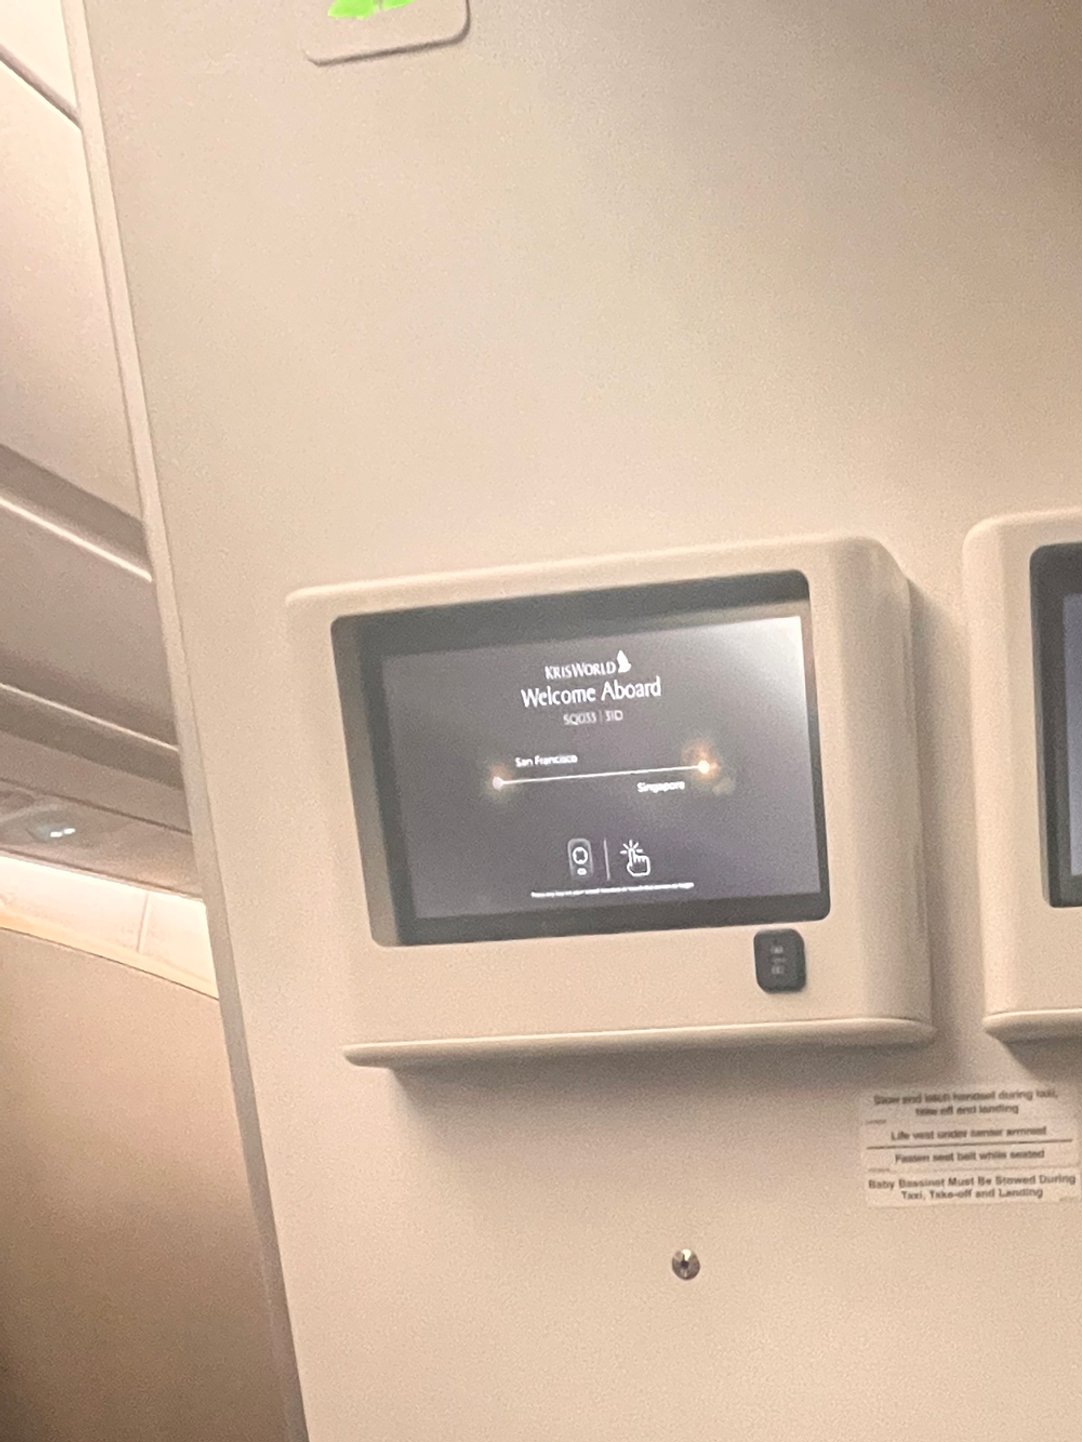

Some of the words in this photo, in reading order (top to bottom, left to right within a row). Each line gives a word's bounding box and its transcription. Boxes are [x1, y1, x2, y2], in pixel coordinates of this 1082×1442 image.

[544, 661, 617, 680] KRISWORLD
[520, 685, 596, 708] Welcome
[601, 675, 662, 701] Aboard
[605, 710, 624, 722] 31D
[515, 756, 533, 767] San
[534, 754, 578, 766] Francisco
[637, 781, 685, 793] Singapore
[998, 1089, 1033, 1101] during
[956, 1106, 977, 1115] and
[978, 1104, 1019, 1114] landing
[890, 1130, 910, 1141] Life
[911, 1129, 934, 1139] vest
[936, 1128, 968, 1139] under
[1006, 1125, 1047, 1136] armrest
[895, 1153, 930, 1164] Fasten
[932, 1152, 954, 1162] seat
[956, 1151, 977, 1161] belt
[978, 1151, 1007, 1160] while
[1010, 1149, 1045, 1159] seated
[868, 1178, 895, 1191] Baby
[898, 1177, 945, 1188] Bassinet
[947, 1176, 974, 1187] Must
[977, 1176, 993, 1186] Be
[995, 1174, 1036, 1186] Stowed
[1038, 1173, 1076, 1186] During
[929, 1188, 973, 1199] Take-off
[975, 1187, 996, 1198] and
[998, 1187, 1043, 1199] Landing
